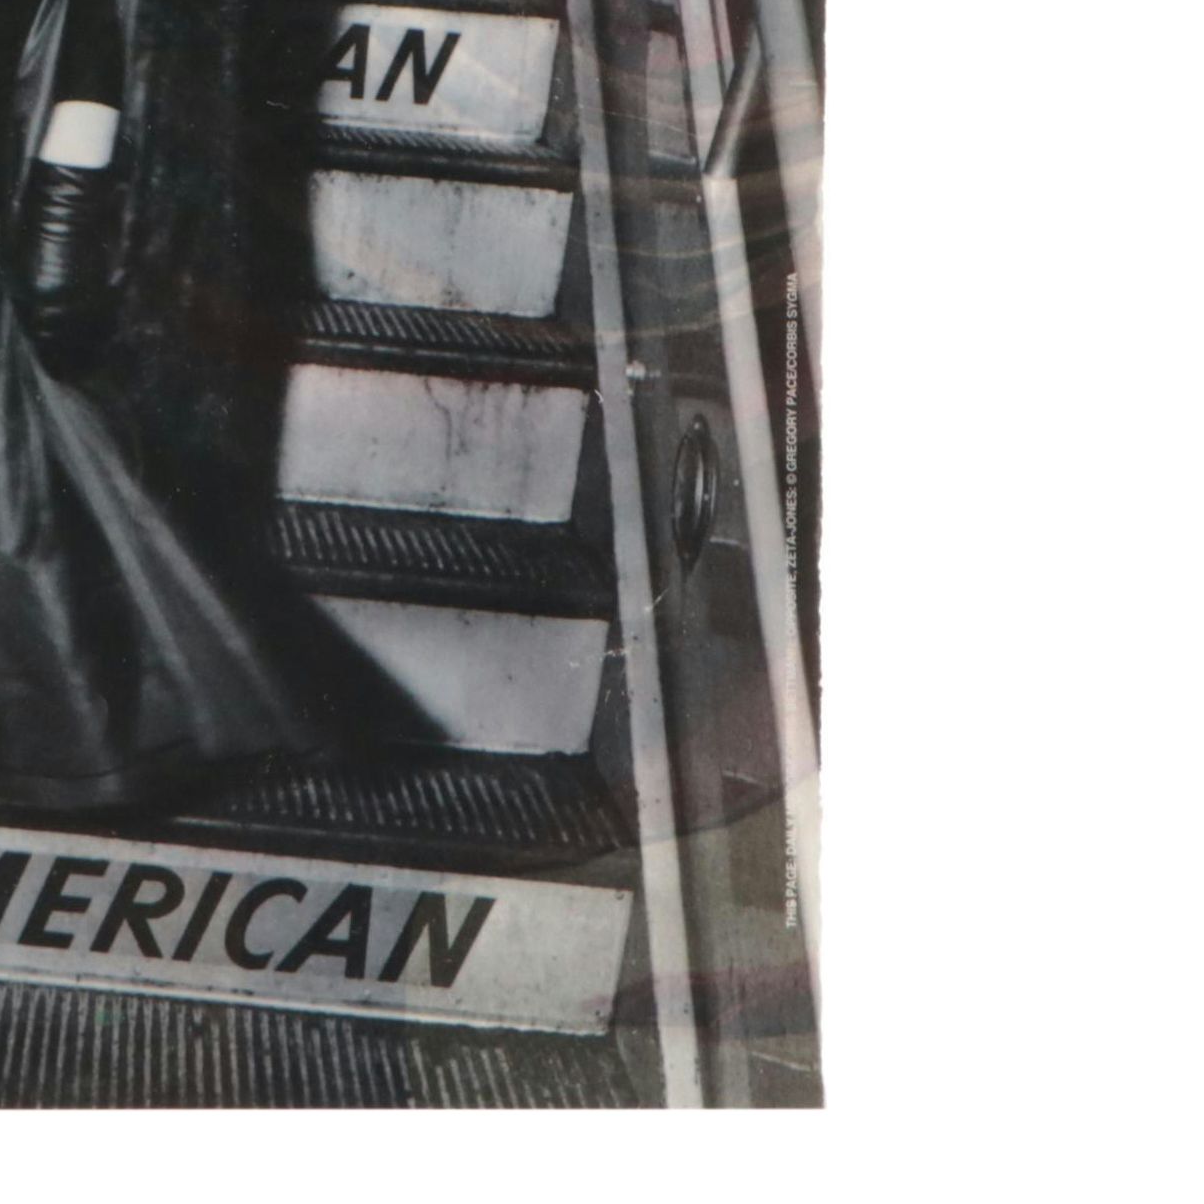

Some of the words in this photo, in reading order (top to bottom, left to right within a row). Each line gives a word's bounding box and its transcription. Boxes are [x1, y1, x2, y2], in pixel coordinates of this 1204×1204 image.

[785, 272, 798, 318] SYGMA
[785, 321, 798, 406] PACE/CORBIS
[785, 408, 798, 472] GREGORY
[785, 487, 798, 568] ZETA-JONES:
[785, 818, 798, 856] DAILY
[785, 859, 798, 898] PAGE:
[785, 899, 798, 929] THIS
